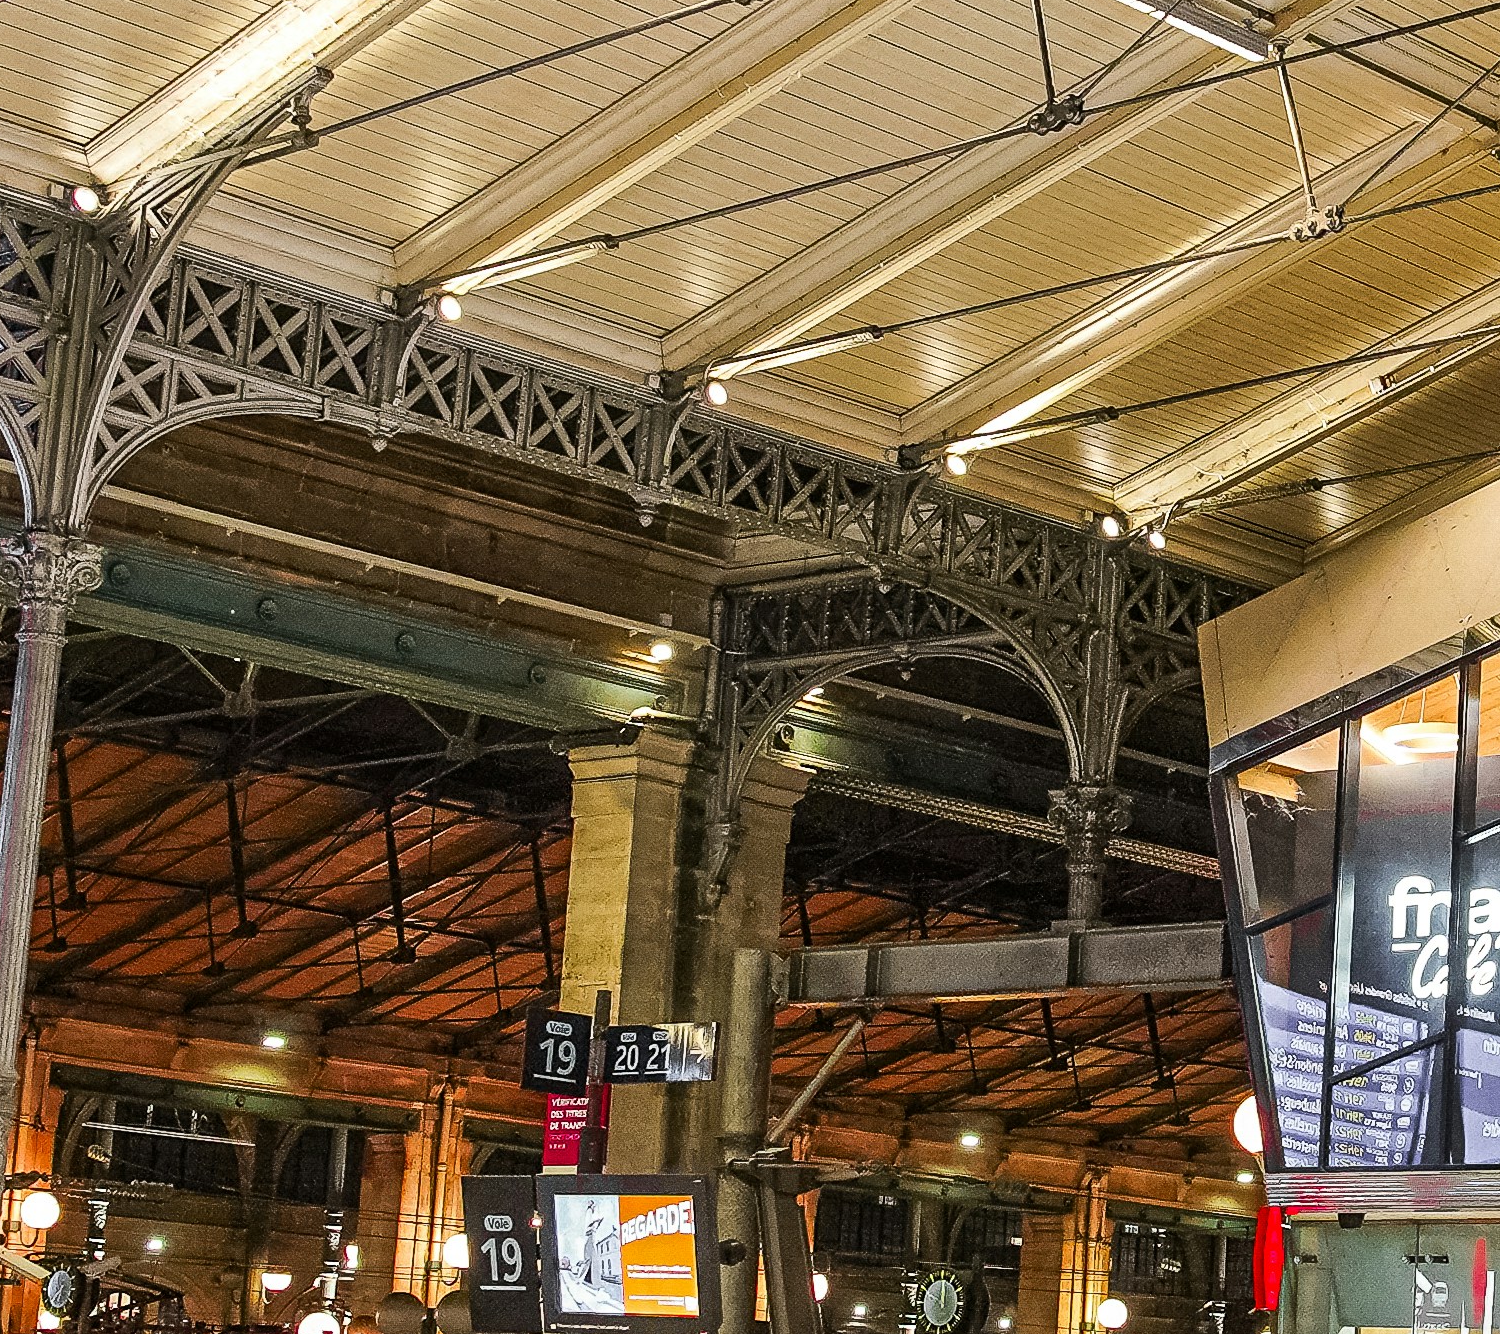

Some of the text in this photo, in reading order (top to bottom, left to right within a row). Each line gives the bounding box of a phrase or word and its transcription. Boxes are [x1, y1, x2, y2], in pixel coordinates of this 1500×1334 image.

[549, 1023, 570, 1034] Voie
[539, 1038, 576, 1075] 19
[614, 1043, 671, 1071] 20 21
[488, 1217, 510, 1229] Voie
[621, 1200, 695, 1246] REGARDE
[480, 1237, 522, 1283] 19
